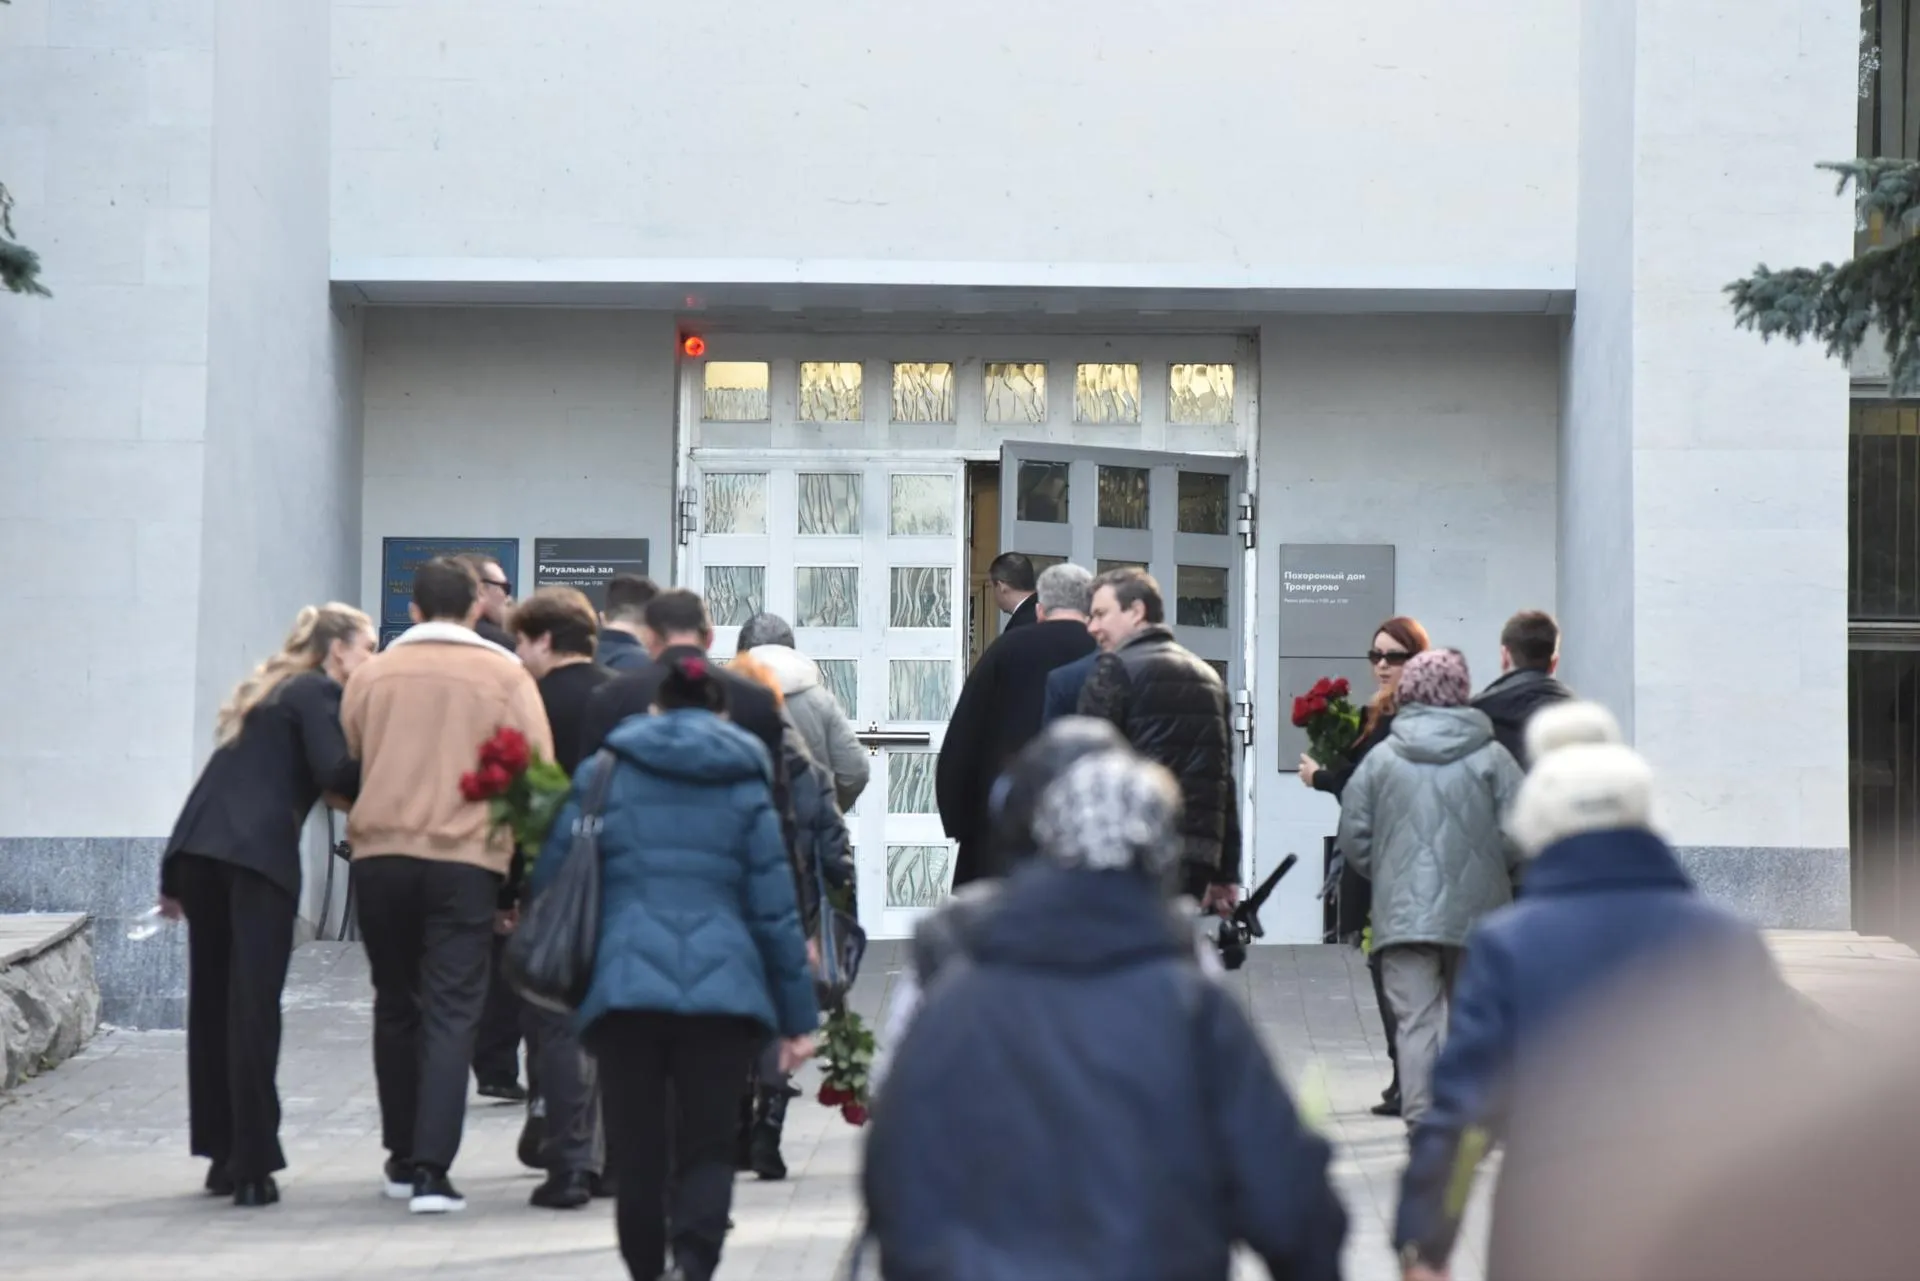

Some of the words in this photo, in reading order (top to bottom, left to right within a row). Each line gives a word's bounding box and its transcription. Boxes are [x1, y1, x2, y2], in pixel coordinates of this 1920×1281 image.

[539, 565, 595, 575] Ритуальный
[1284, 571, 1344, 581] Похоронный
[1346, 573, 1366, 581] дом
[1284, 582, 1339, 592] Троекурово
